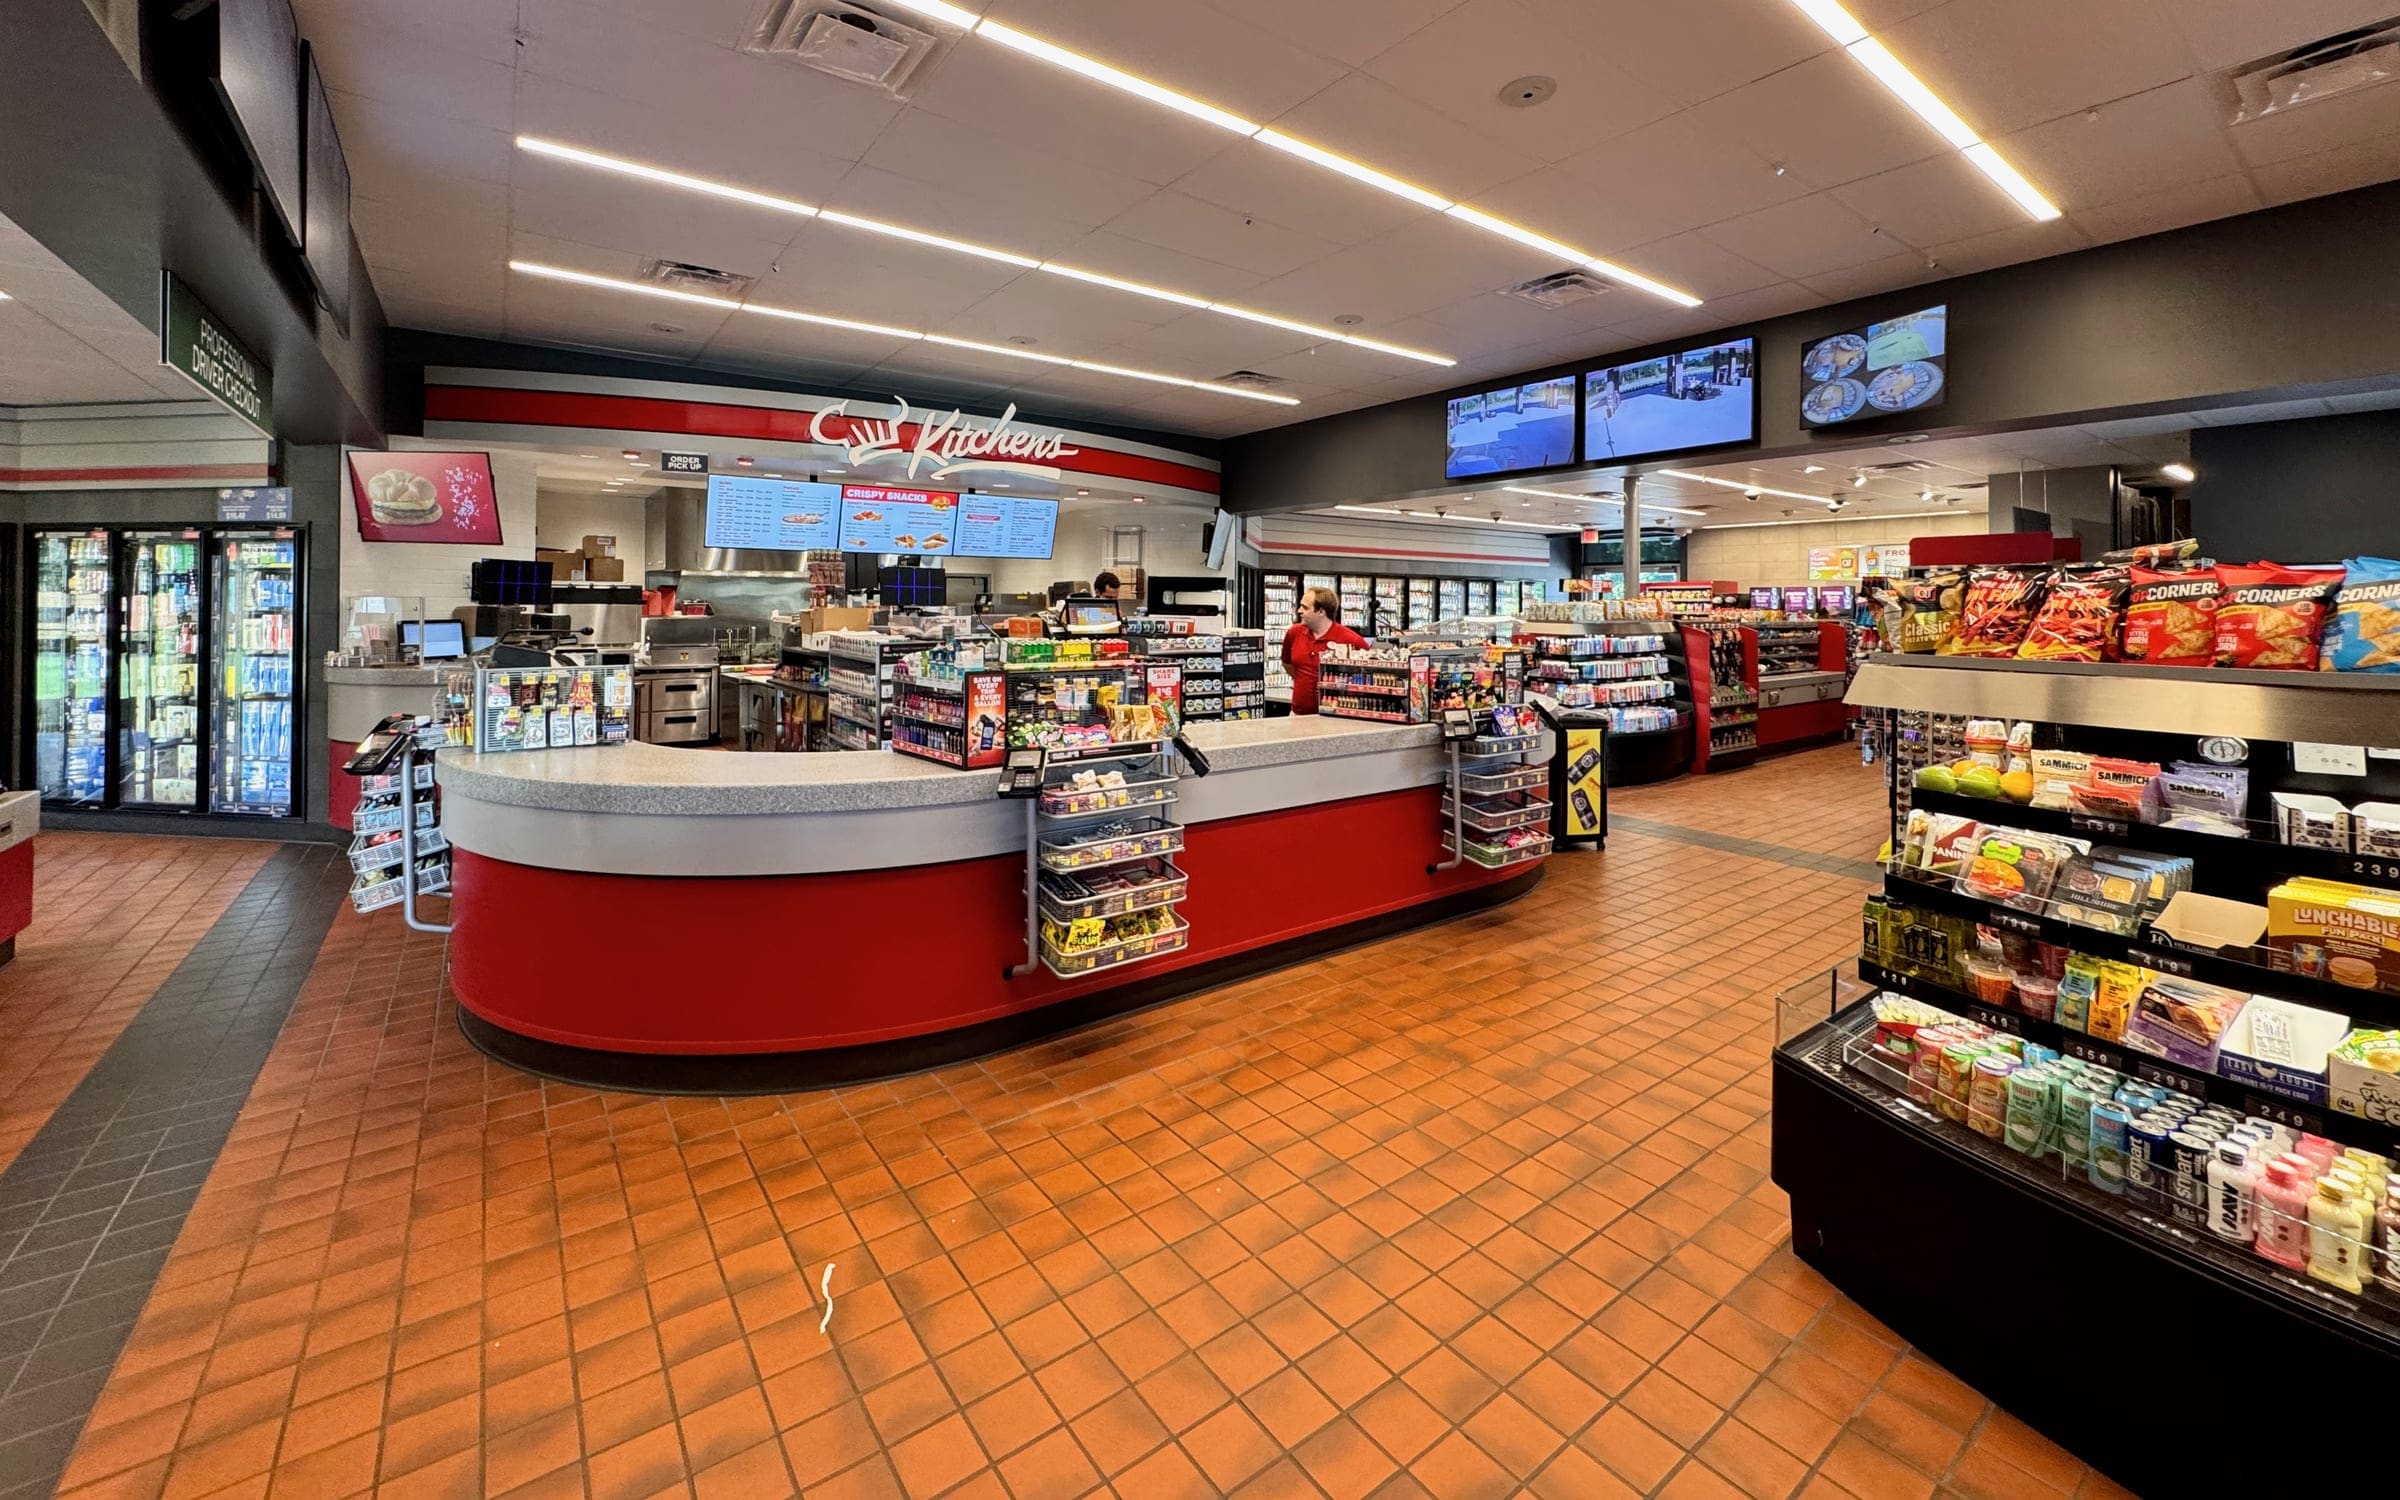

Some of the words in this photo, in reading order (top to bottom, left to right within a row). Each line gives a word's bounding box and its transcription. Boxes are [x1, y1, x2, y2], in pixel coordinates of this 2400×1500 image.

[200, 317, 257, 391] PROFESSIONAL
[192, 343, 224, 393] DRIVER
[225, 372, 262, 420] CHECKOUT
[907, 402, 1080, 480] Kitchens
[668, 462, 688, 471] PICK
[689, 463, 702, 471] UP
[670, 455, 700, 464] ORDER
[846, 488, 885, 500] CRISPY
[886, 490, 928, 502] SNACKS
[1916, 588, 1933, 599] QT
[1905, 622, 1950, 638] Classic
[976, 682, 999, 690] EVERY
[2039, 758, 2088, 771] SAMMICH
[2097, 771, 2150, 785] SAMMICH
[2169, 783, 2225, 800] SAMMICH
[1931, 846, 1967, 860] PANIN
[2353, 861, 2400, 879] 239
[2294, 908, 2400, 940] LUNCHABLE
[2321, 926, 2345, 936] FUN
[1071, 935, 1097, 945] SOUR
[1881, 971, 1907, 986] 429
[1980, 1012, 2008, 1027] 249
[2075, 1046, 2107, 1064] 359
[2152, 1071, 2189, 1090] 299
[2261, 1105, 2304, 1127] 249
[2129, 1135, 2143, 1181] smart
[2175, 1148, 2193, 1200] smart
